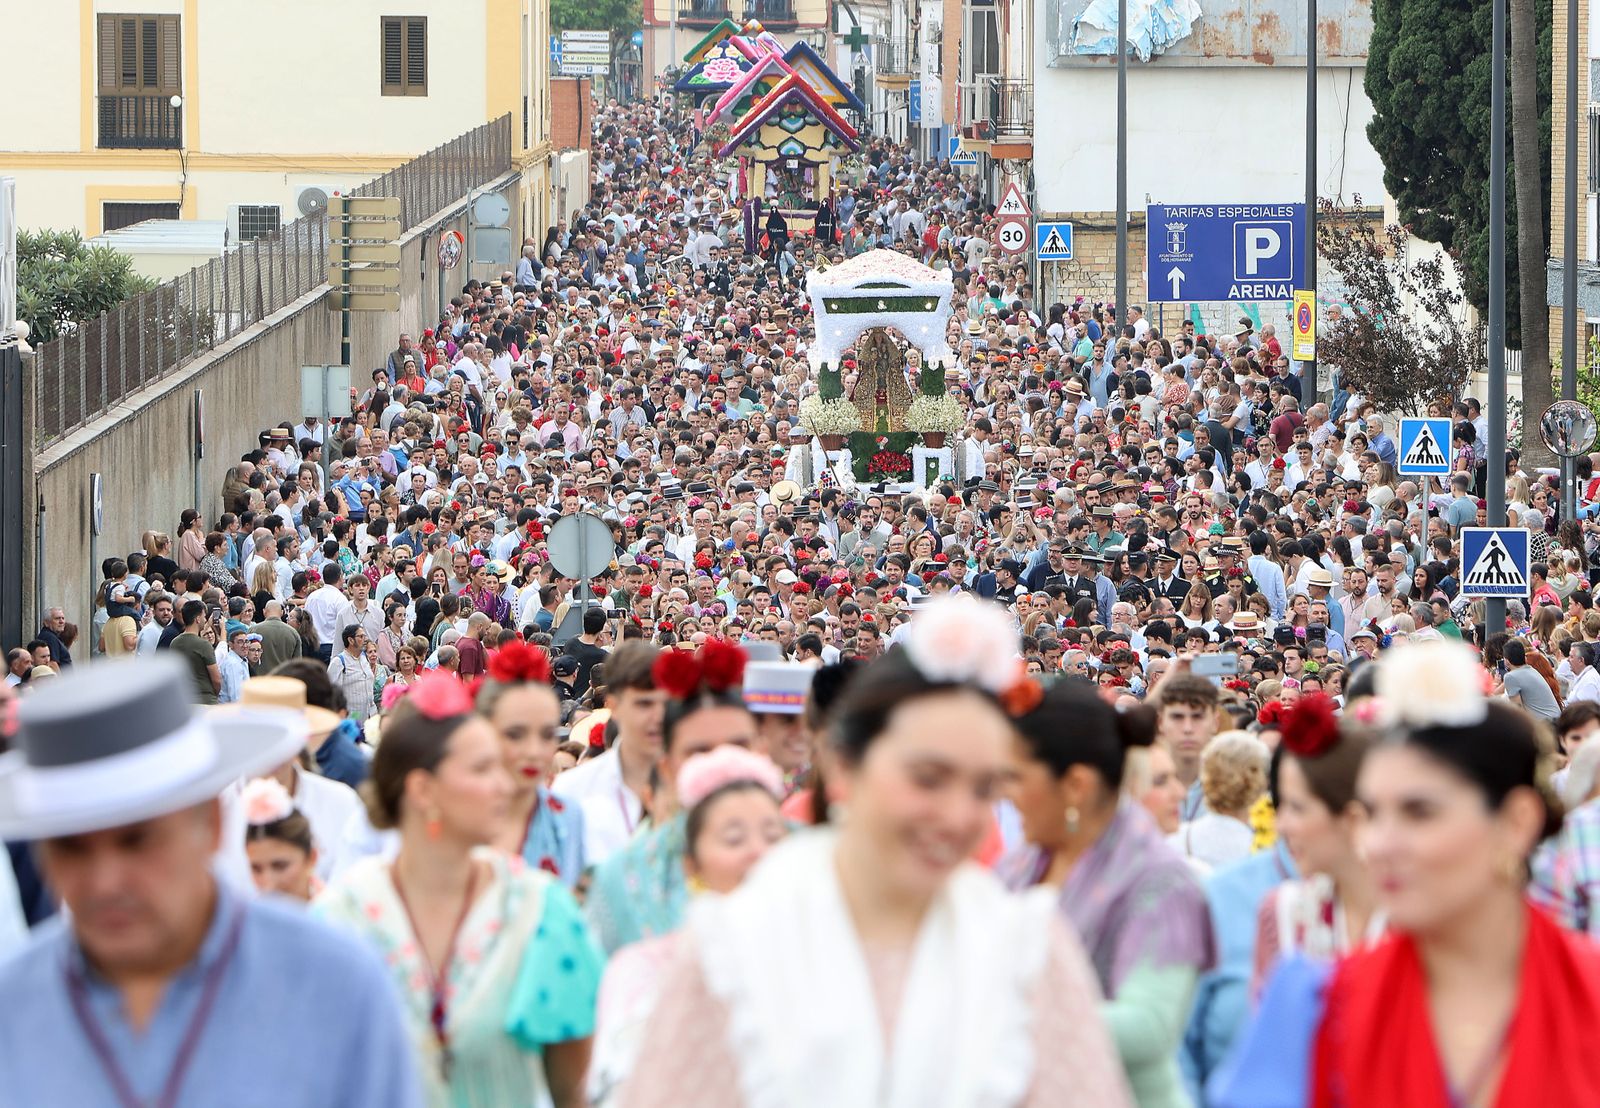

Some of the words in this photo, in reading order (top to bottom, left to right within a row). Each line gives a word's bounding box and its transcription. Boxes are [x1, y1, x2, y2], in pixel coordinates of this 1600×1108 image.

[1164, 207, 1214, 218] TARIFAS
[1218, 206, 1294, 218] ESPECIALES
[1002, 230, 1023, 242] 30
[1245, 228, 1281, 275] P
